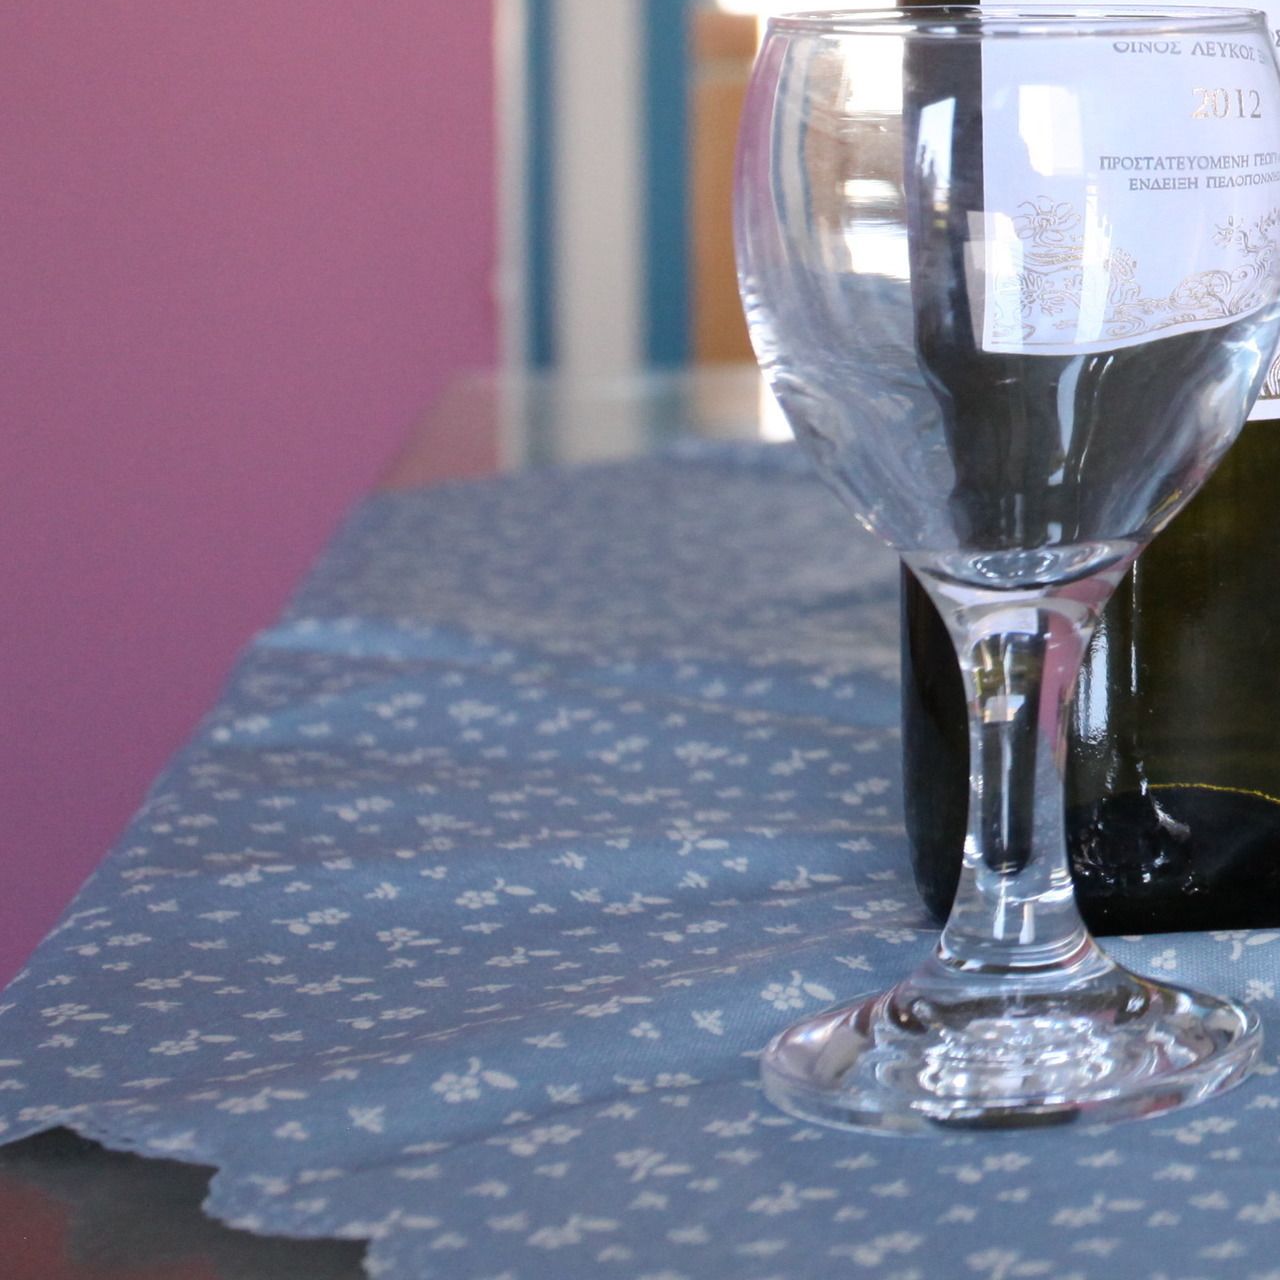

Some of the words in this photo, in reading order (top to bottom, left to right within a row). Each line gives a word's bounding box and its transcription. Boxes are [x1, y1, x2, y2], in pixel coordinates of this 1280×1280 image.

[1191, 87, 1262, 118] 2012
[1100, 155, 1248, 171] ΠΡΟΣΤΑΤΕΥΟΜΕΝΗ
[1129, 175, 1198, 191] ΕΝΔΕΙΞΗ
